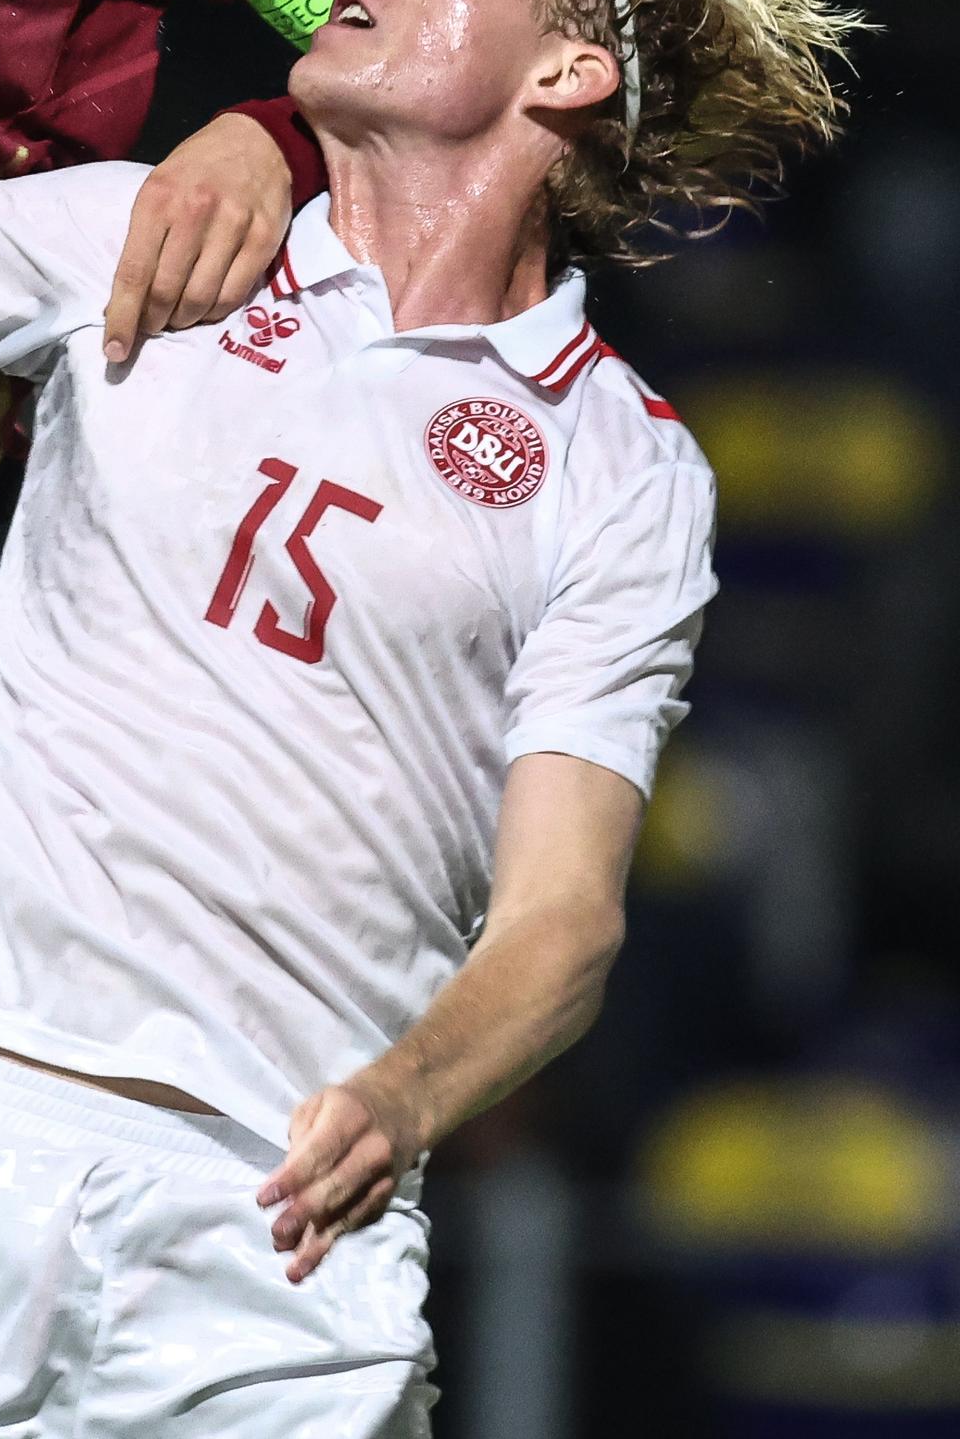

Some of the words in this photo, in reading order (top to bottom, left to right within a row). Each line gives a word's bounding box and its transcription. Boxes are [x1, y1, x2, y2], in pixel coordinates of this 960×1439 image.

[219, 330, 287, 374] hummel
[430, 406, 465, 460] DANSK
[449, 421, 525, 482] DBU
[441, 467, 485, 500] 1889
[493, 463, 544, 504] UNION
[203, 457, 385, 665] 15
